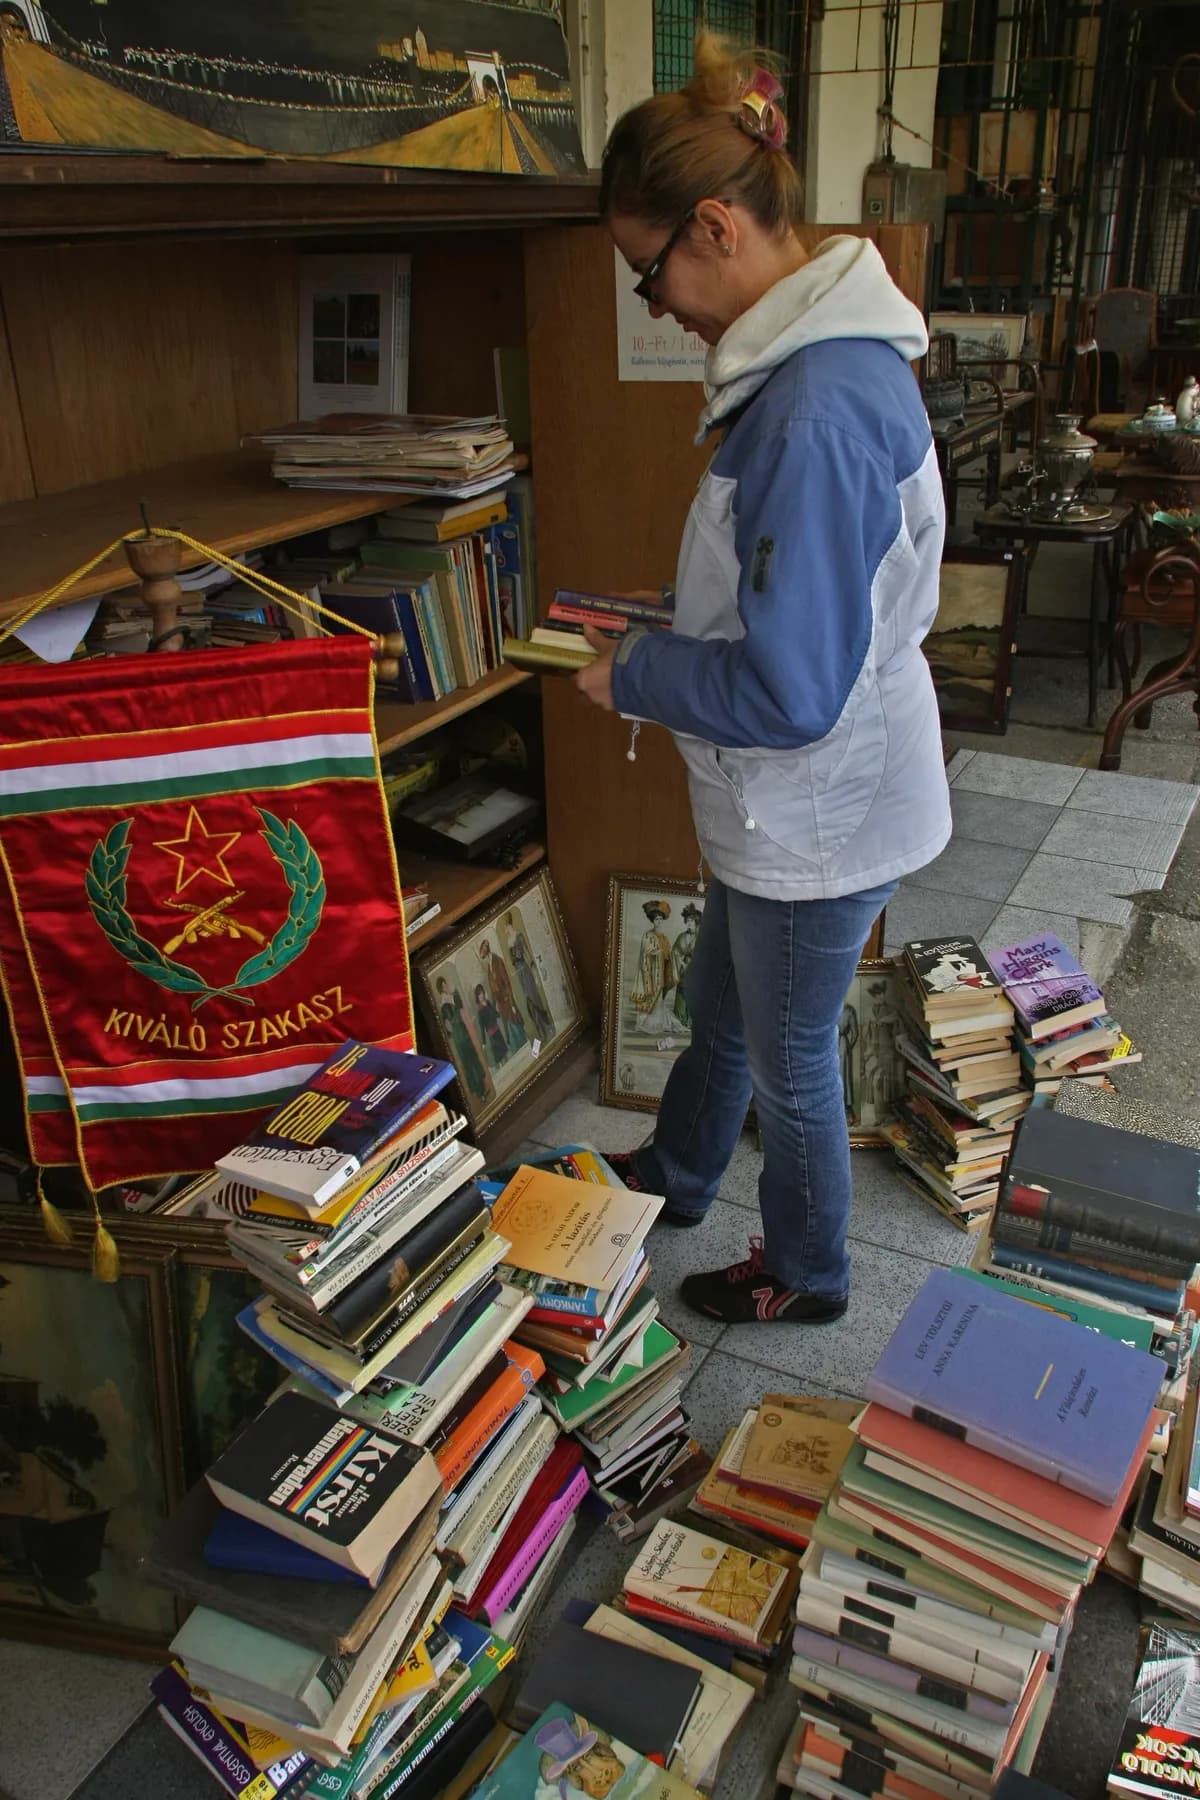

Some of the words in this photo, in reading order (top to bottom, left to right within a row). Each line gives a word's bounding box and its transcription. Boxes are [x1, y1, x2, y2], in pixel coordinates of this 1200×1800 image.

[1002, 946, 1062, 973] Higgins
[1006, 940, 1047, 960] Mary
[1010, 959, 1054, 980] Clark
[104, 1008, 206, 1051] KIVÁLÓ
[222, 986, 352, 1048] SZAKASZ
[325, 1045, 368, 1077] 97
[361, 1077, 400, 1111] for
[266, 1091, 351, 1145] WORD
[232, 1145, 344, 1171] Egyszerűen
[395, 1145, 433, 1179] KRISZTUS
[564, 1209, 593, 1243] lazítás
[559, 1239, 571, 1251] A
[395, 1291, 417, 1312] 1975
[913, 1339, 931, 1360] LEV
[931, 1348, 953, 1376] ANNA
[945, 1300, 979, 1349] KARENINA
[393, 1411, 422, 1428] ÉLET
[410, 1404, 428, 1416] AZ
[1054, 1413, 1065, 1422] A
[459, 1405, 510, 1462] TANULJUNK
[268, 1417, 358, 1506] Kameraden
[304, 1432, 403, 1527] Kirst
[504, 1467, 529, 1501] HOGYAN
[336, 1484, 367, 1518] Hellmut
[348, 1491, 371, 1514] Hans
[179, 1703, 218, 1743] ENGLISH
[409, 1739, 436, 1768] PENTRU
[431, 1716, 455, 1742] TESTUL
[208, 1738, 254, 1785] ESSENTIAL
